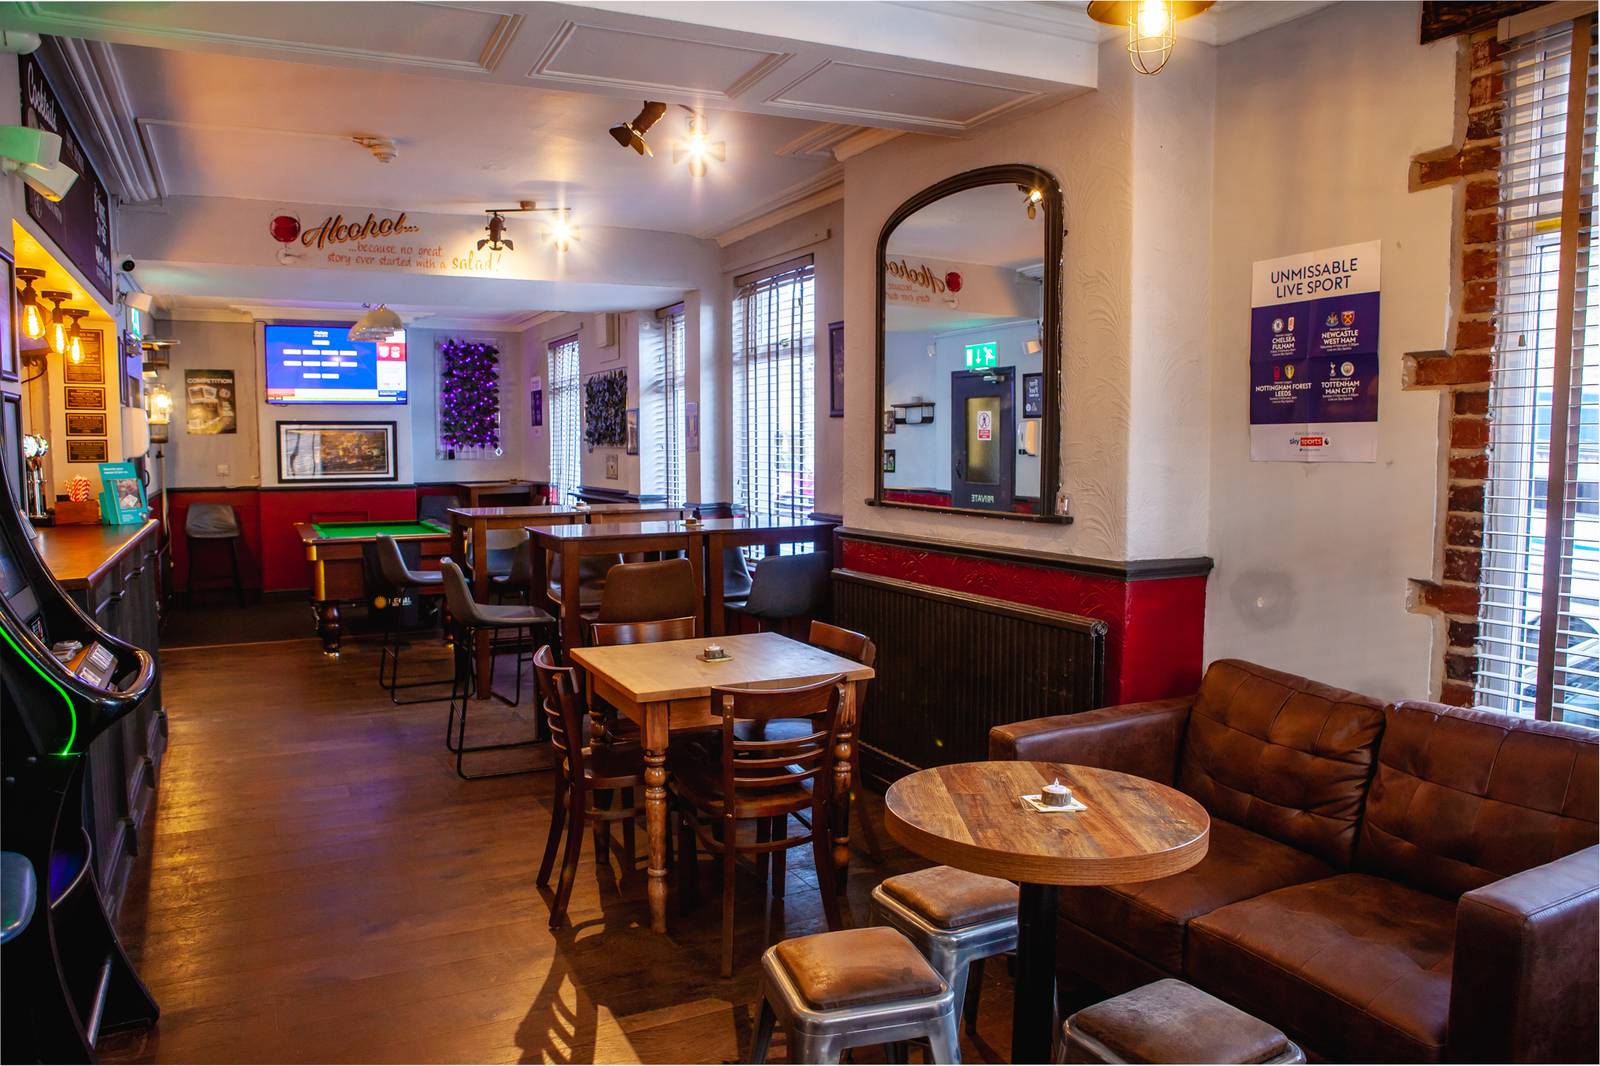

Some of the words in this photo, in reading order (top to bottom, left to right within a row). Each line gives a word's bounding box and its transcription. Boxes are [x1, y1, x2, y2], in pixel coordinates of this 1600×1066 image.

[27, 61, 58, 132] Cocktails
[400, 247, 414, 255] no
[418, 246, 442, 258] great
[327, 253, 350, 266] story
[355, 256, 375, 265] ever
[379, 256, 411, 267] started
[416, 259, 436, 270] with
[452, 250, 501, 272] salad!
[1271, 257, 1358, 284] UNMISSABLE
[1276, 282, 1303, 298] LIVE
[1307, 275, 1351, 294] SPORT
[1321, 329, 1359, 339] NEWCASTLE
[1272, 336, 1296, 344] CHELSEA
[1323, 337, 1339, 345] WEST
[186, 377, 233, 385] COMPETITION
[1321, 380, 1360, 389] TOTTENHAM
[1255, 384, 1292, 392] NOTTINGHAM
[1292, 382, 1313, 390] FOREST
[1341, 386, 1356, 394] CITY
